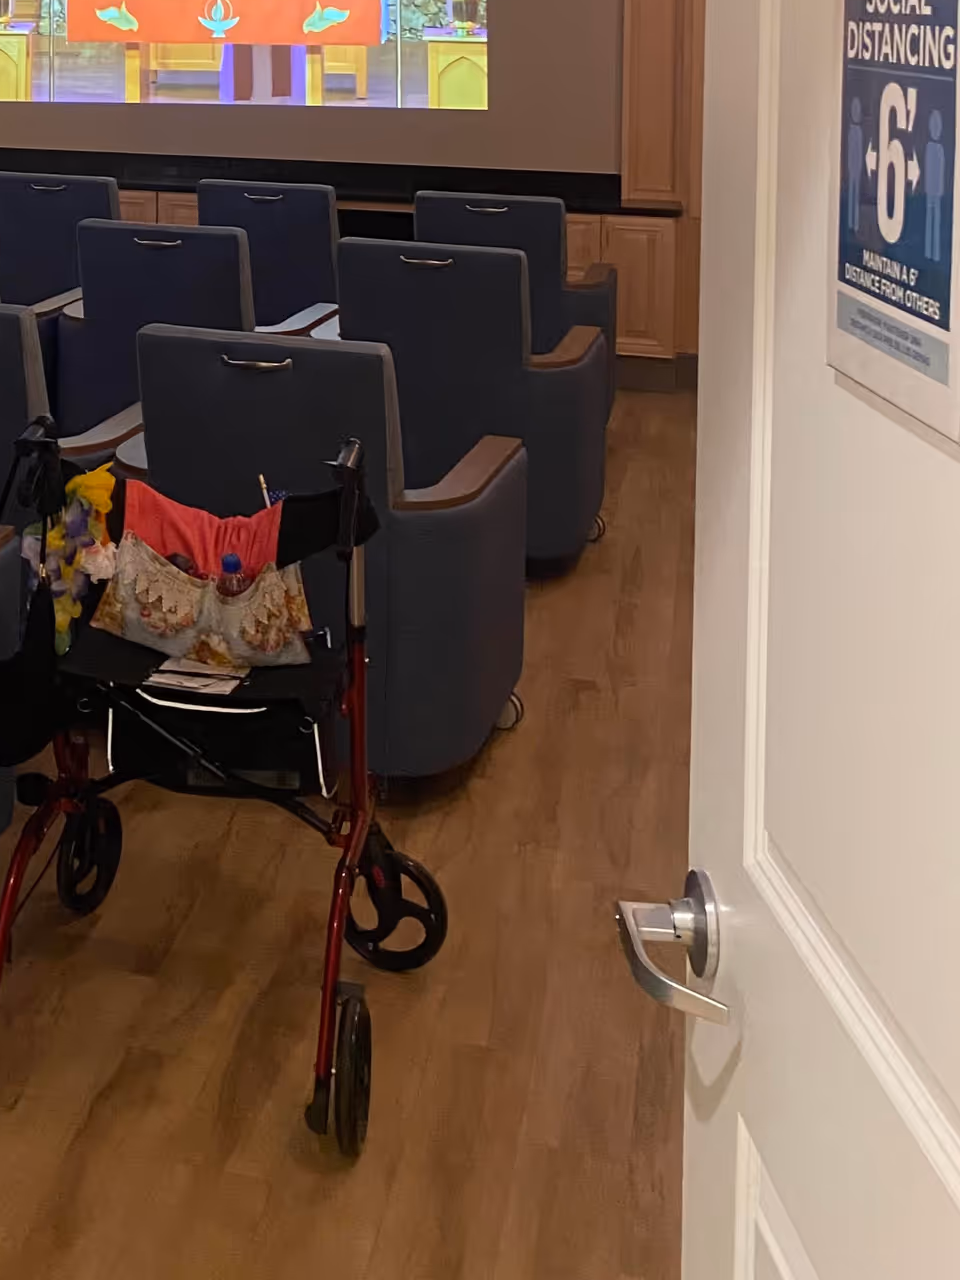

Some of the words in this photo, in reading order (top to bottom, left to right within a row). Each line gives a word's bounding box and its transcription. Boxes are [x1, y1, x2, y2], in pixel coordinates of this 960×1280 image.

[847, 20, 955, 70] DISTANCING
[844, 262, 880, 294] DISTANCE
[880, 279, 905, 306] FROM
[905, 290, 941, 321] OTHERS
[862, 248, 901, 282] MAINTAIN
[901, 265, 909, 285] A
